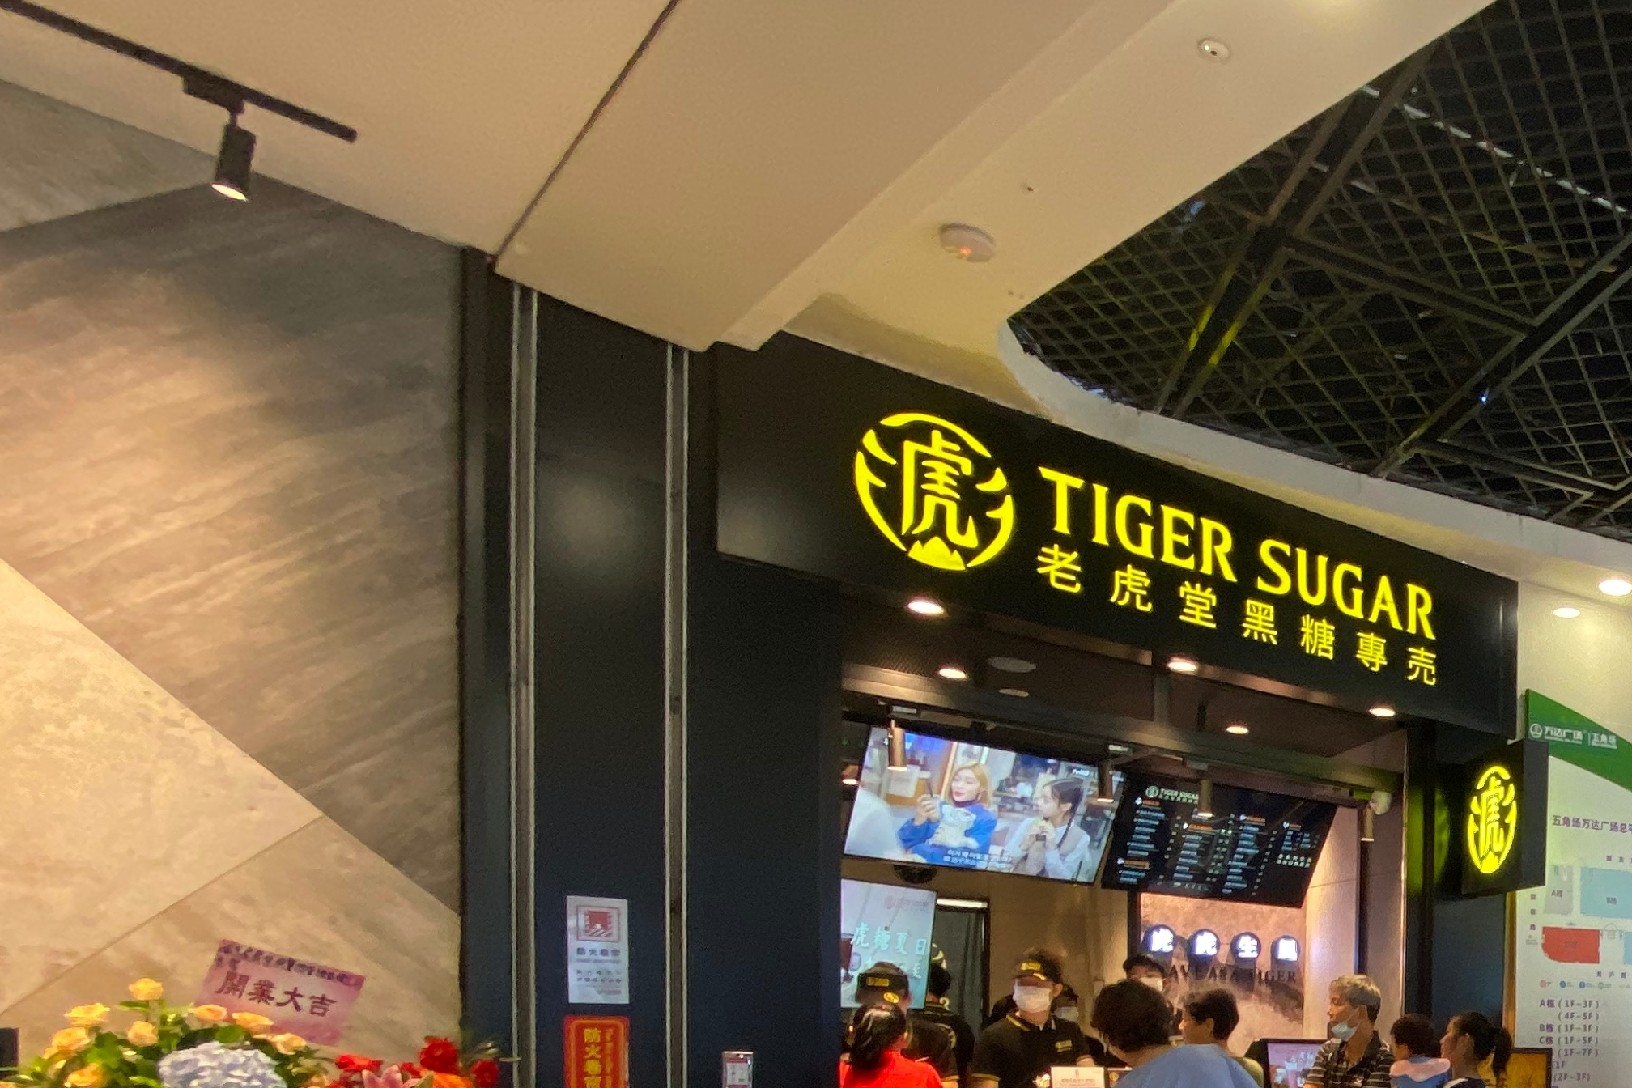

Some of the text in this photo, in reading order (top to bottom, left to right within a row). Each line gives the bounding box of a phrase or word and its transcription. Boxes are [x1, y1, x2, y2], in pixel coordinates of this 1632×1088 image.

[1037, 466, 1437, 641] TIGER SUGAR
[215, 970, 337, 1017] 開業大吉
